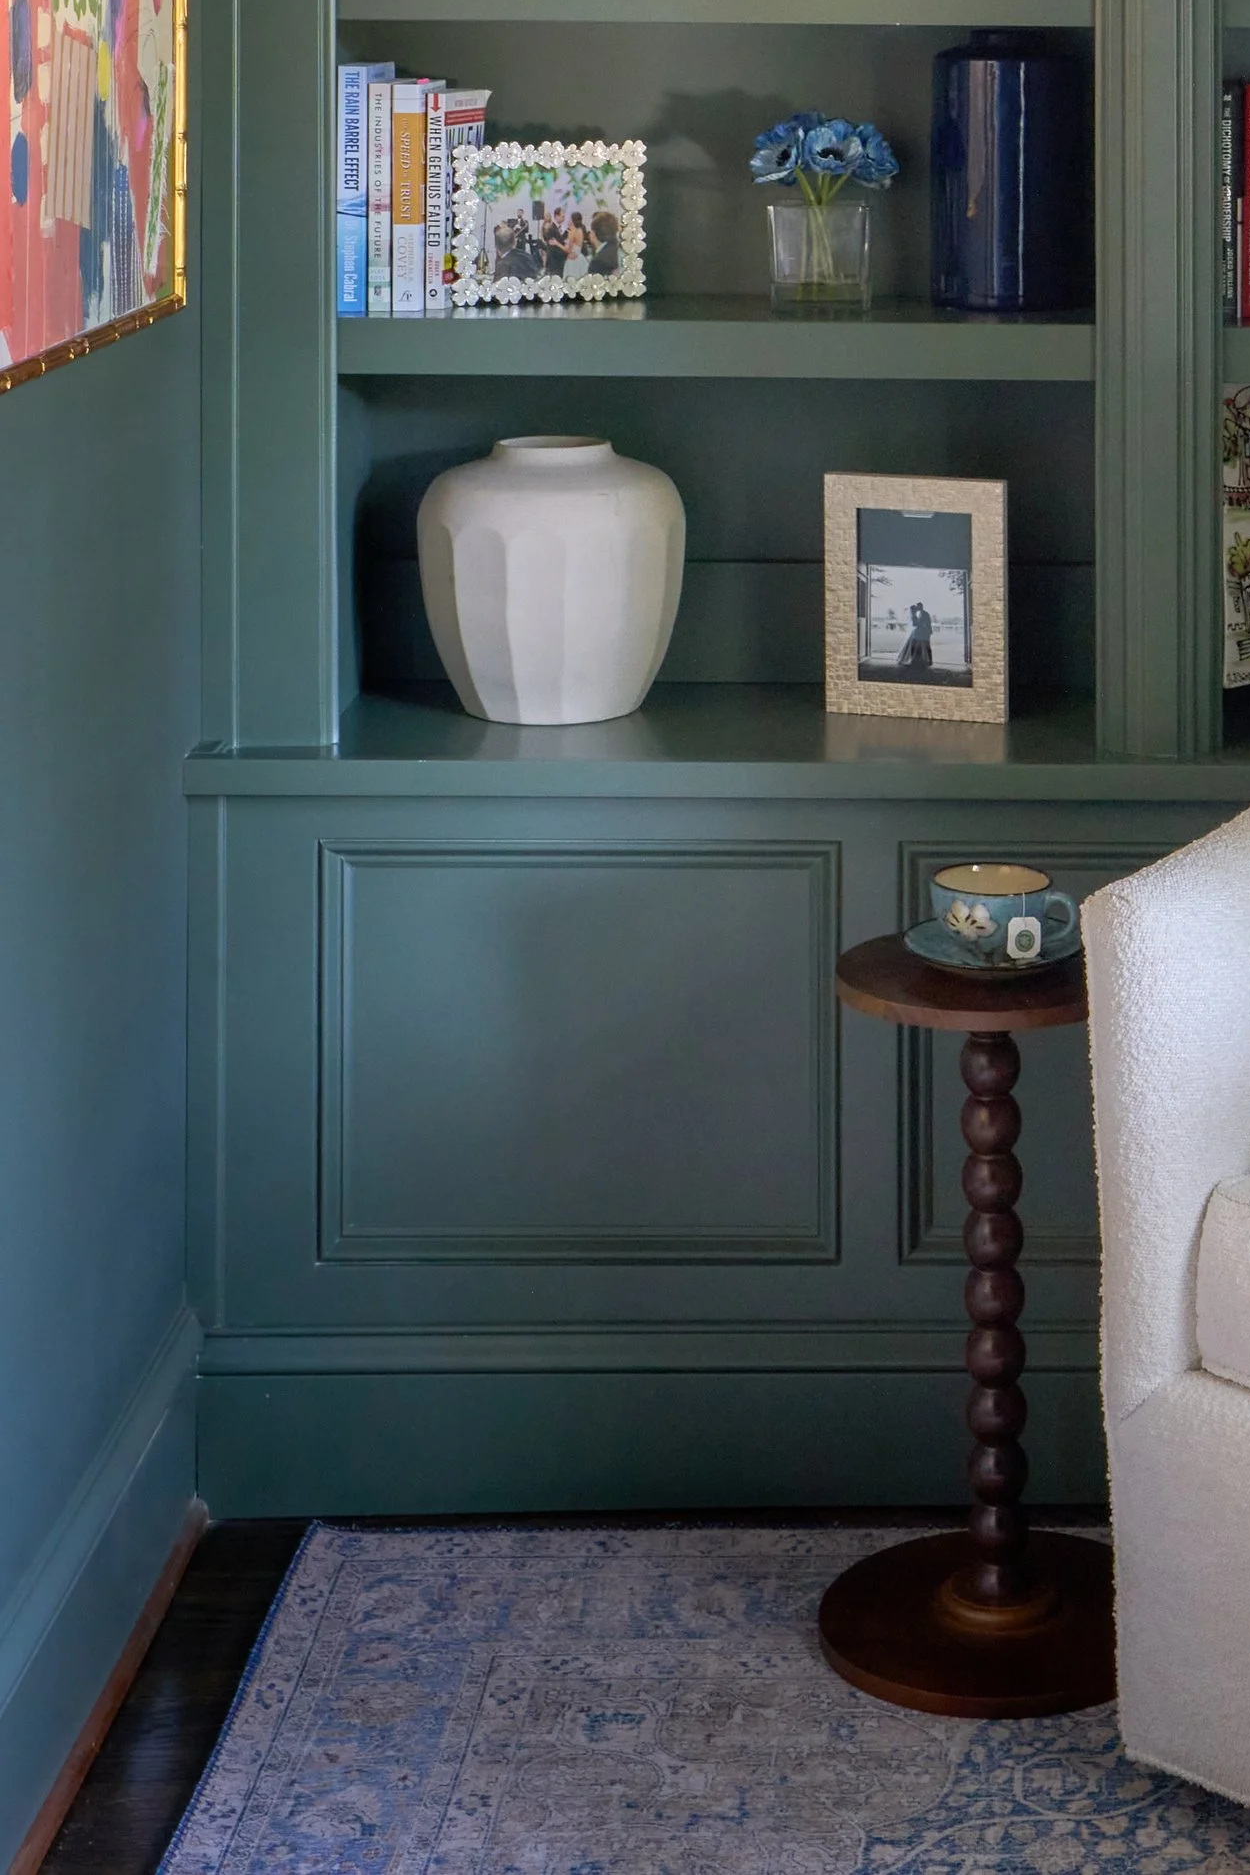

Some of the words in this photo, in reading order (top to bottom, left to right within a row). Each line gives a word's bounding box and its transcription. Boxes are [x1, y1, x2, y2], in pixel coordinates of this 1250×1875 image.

[344, 71, 359, 89] THE
[344, 91, 359, 115] RAIN
[374, 93, 383, 111] THE
[344, 118, 359, 156] BARREL
[374, 115, 383, 175] INDUSTRIES
[400, 131, 411, 170] SPEED
[428, 116, 442, 152] WHEN
[1221, 119, 1232, 175] DICHOTOMY
[344, 157, 359, 192] EFFECT
[374, 179, 383, 193] OF
[428, 156, 442, 200] GENIUS
[374, 197, 383, 216] THE
[400, 181, 411, 221] TRUST
[1221, 186, 1232, 243] LEADERSHIP
[374, 220, 383, 259] FUTURE
[428, 204, 442, 248] FAILED
[340, 236, 358, 271] Stephen
[397, 236, 408, 280] COVEY
[343, 273, 358, 302] Cabral
